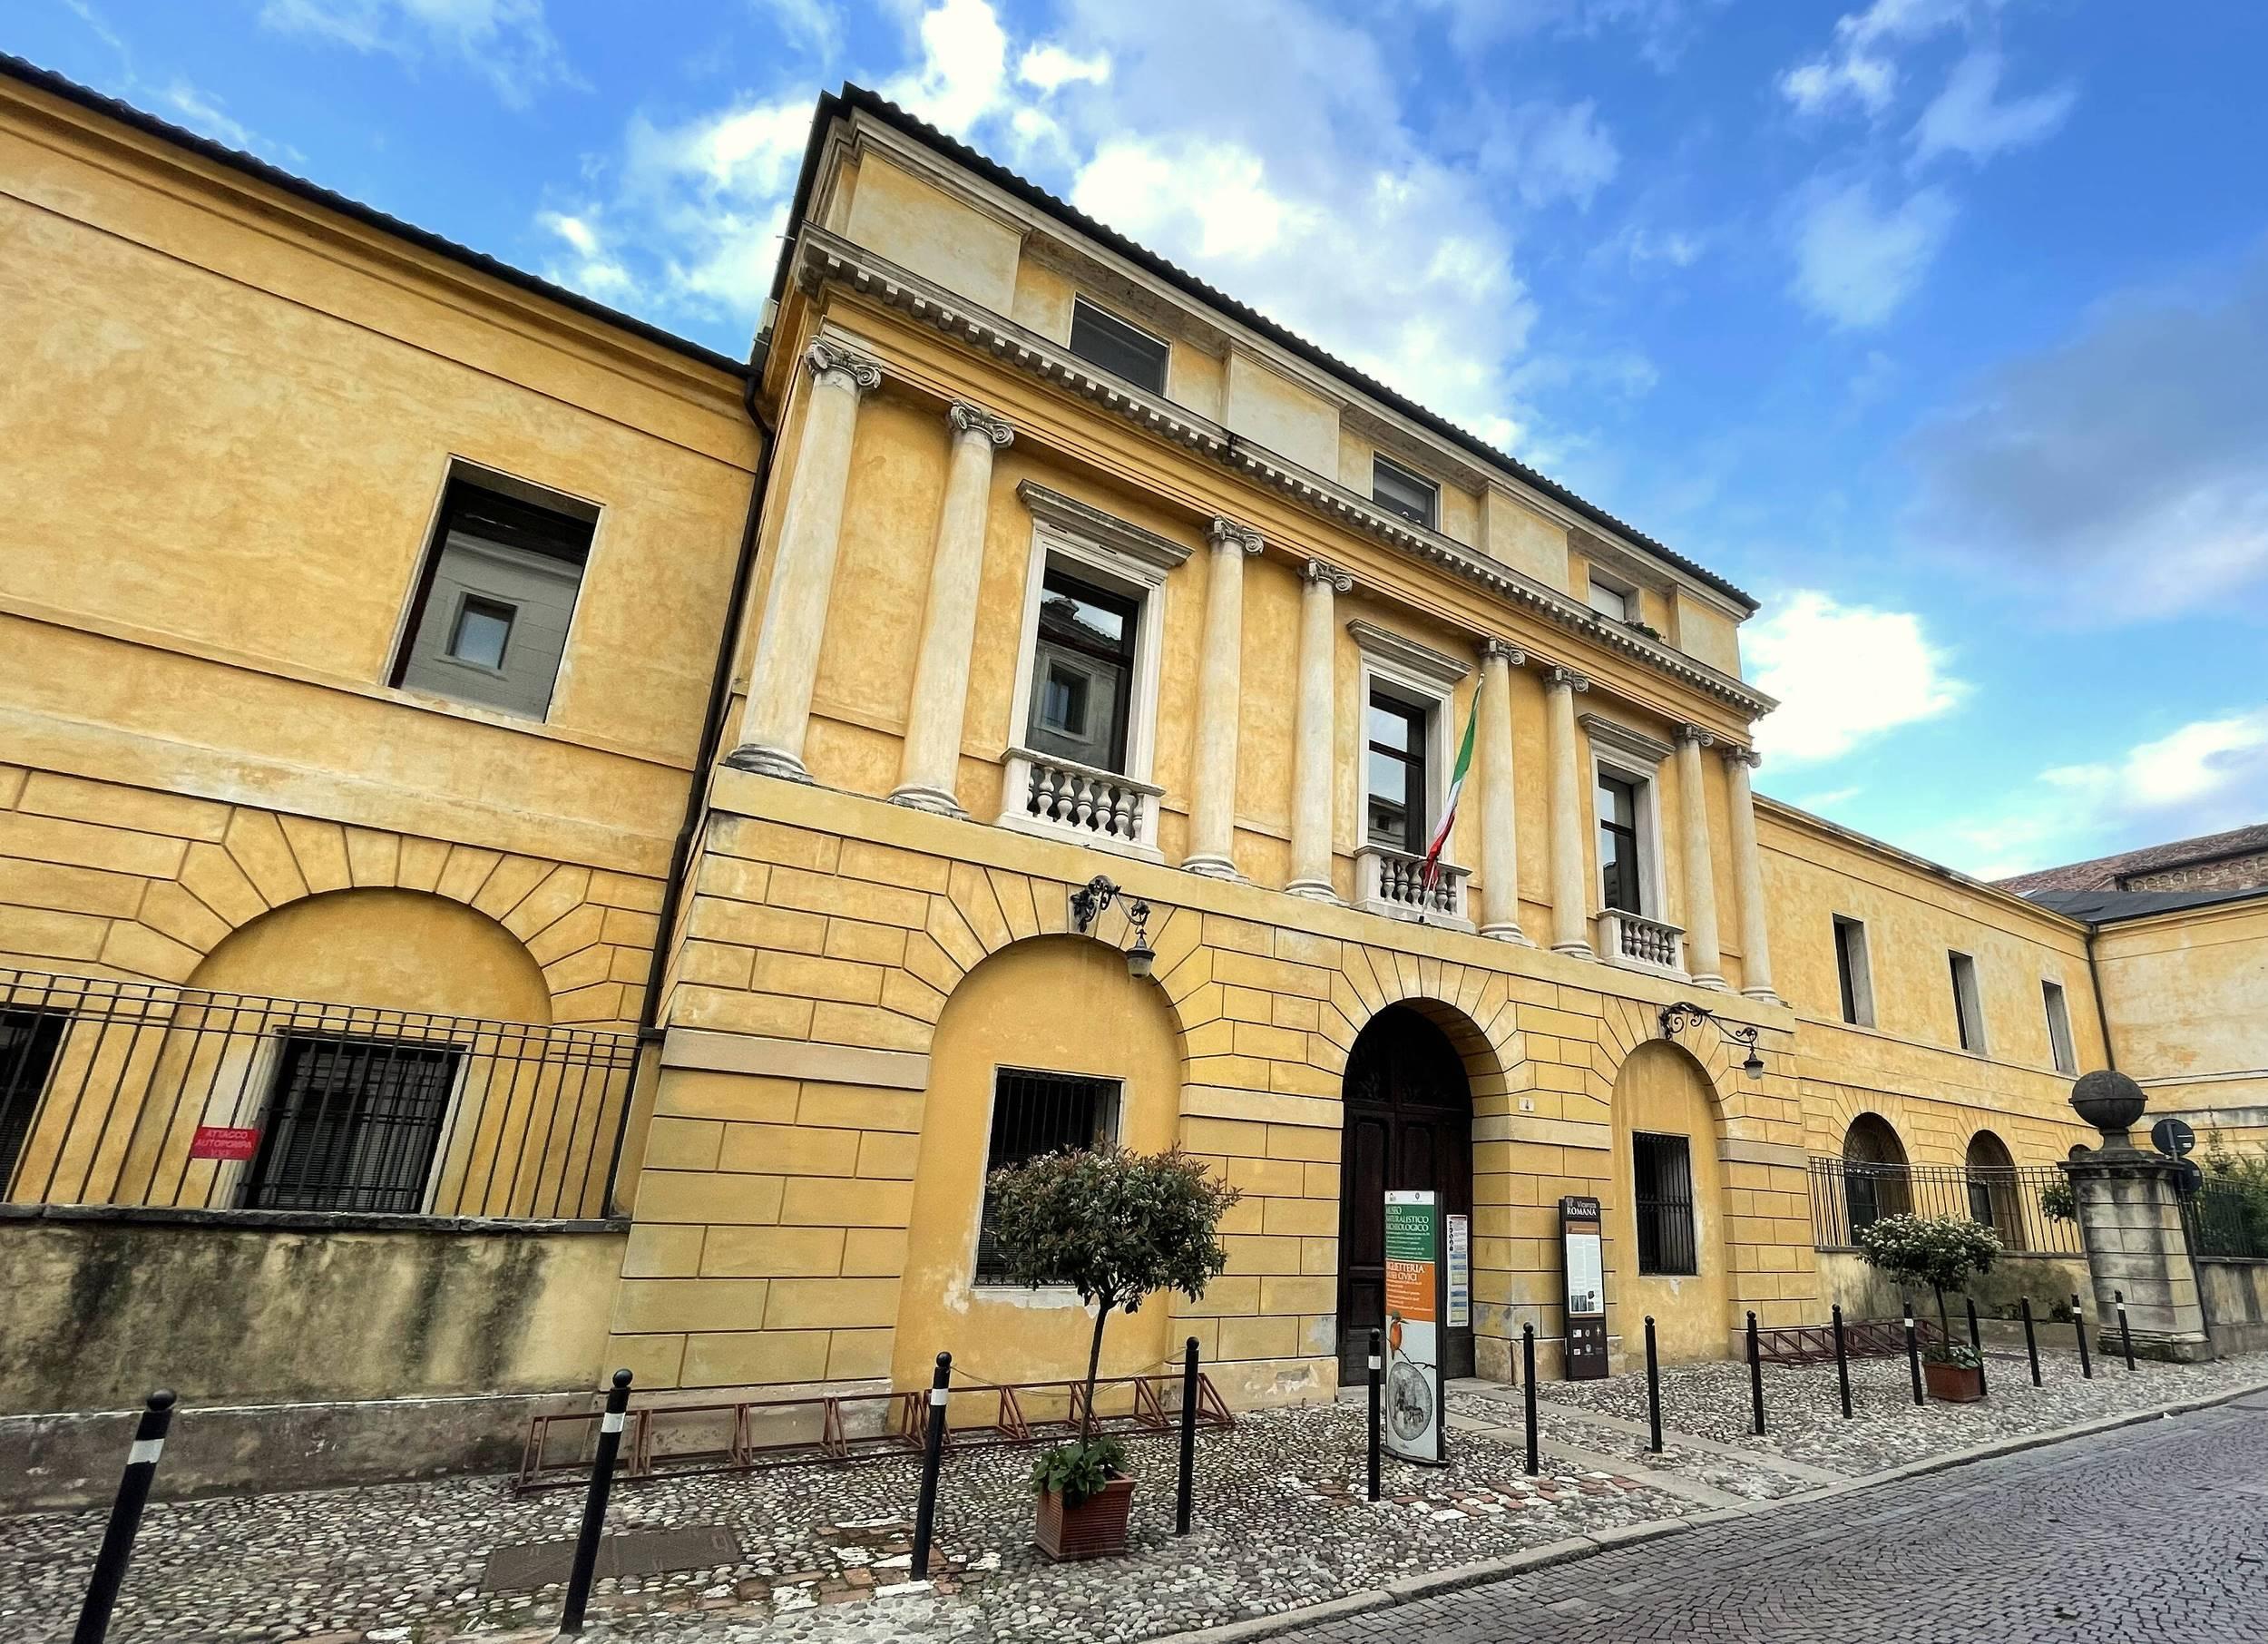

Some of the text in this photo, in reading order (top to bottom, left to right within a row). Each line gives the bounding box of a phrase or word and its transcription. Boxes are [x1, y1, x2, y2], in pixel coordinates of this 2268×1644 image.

[205, 1130, 248, 1139] ATTACCO
[195, 1140, 251, 1148] AUTOPOMPA
[1567, 1207, 1597, 1216] ROMANA
[1398, 1271, 1418, 1282] CIVICI
